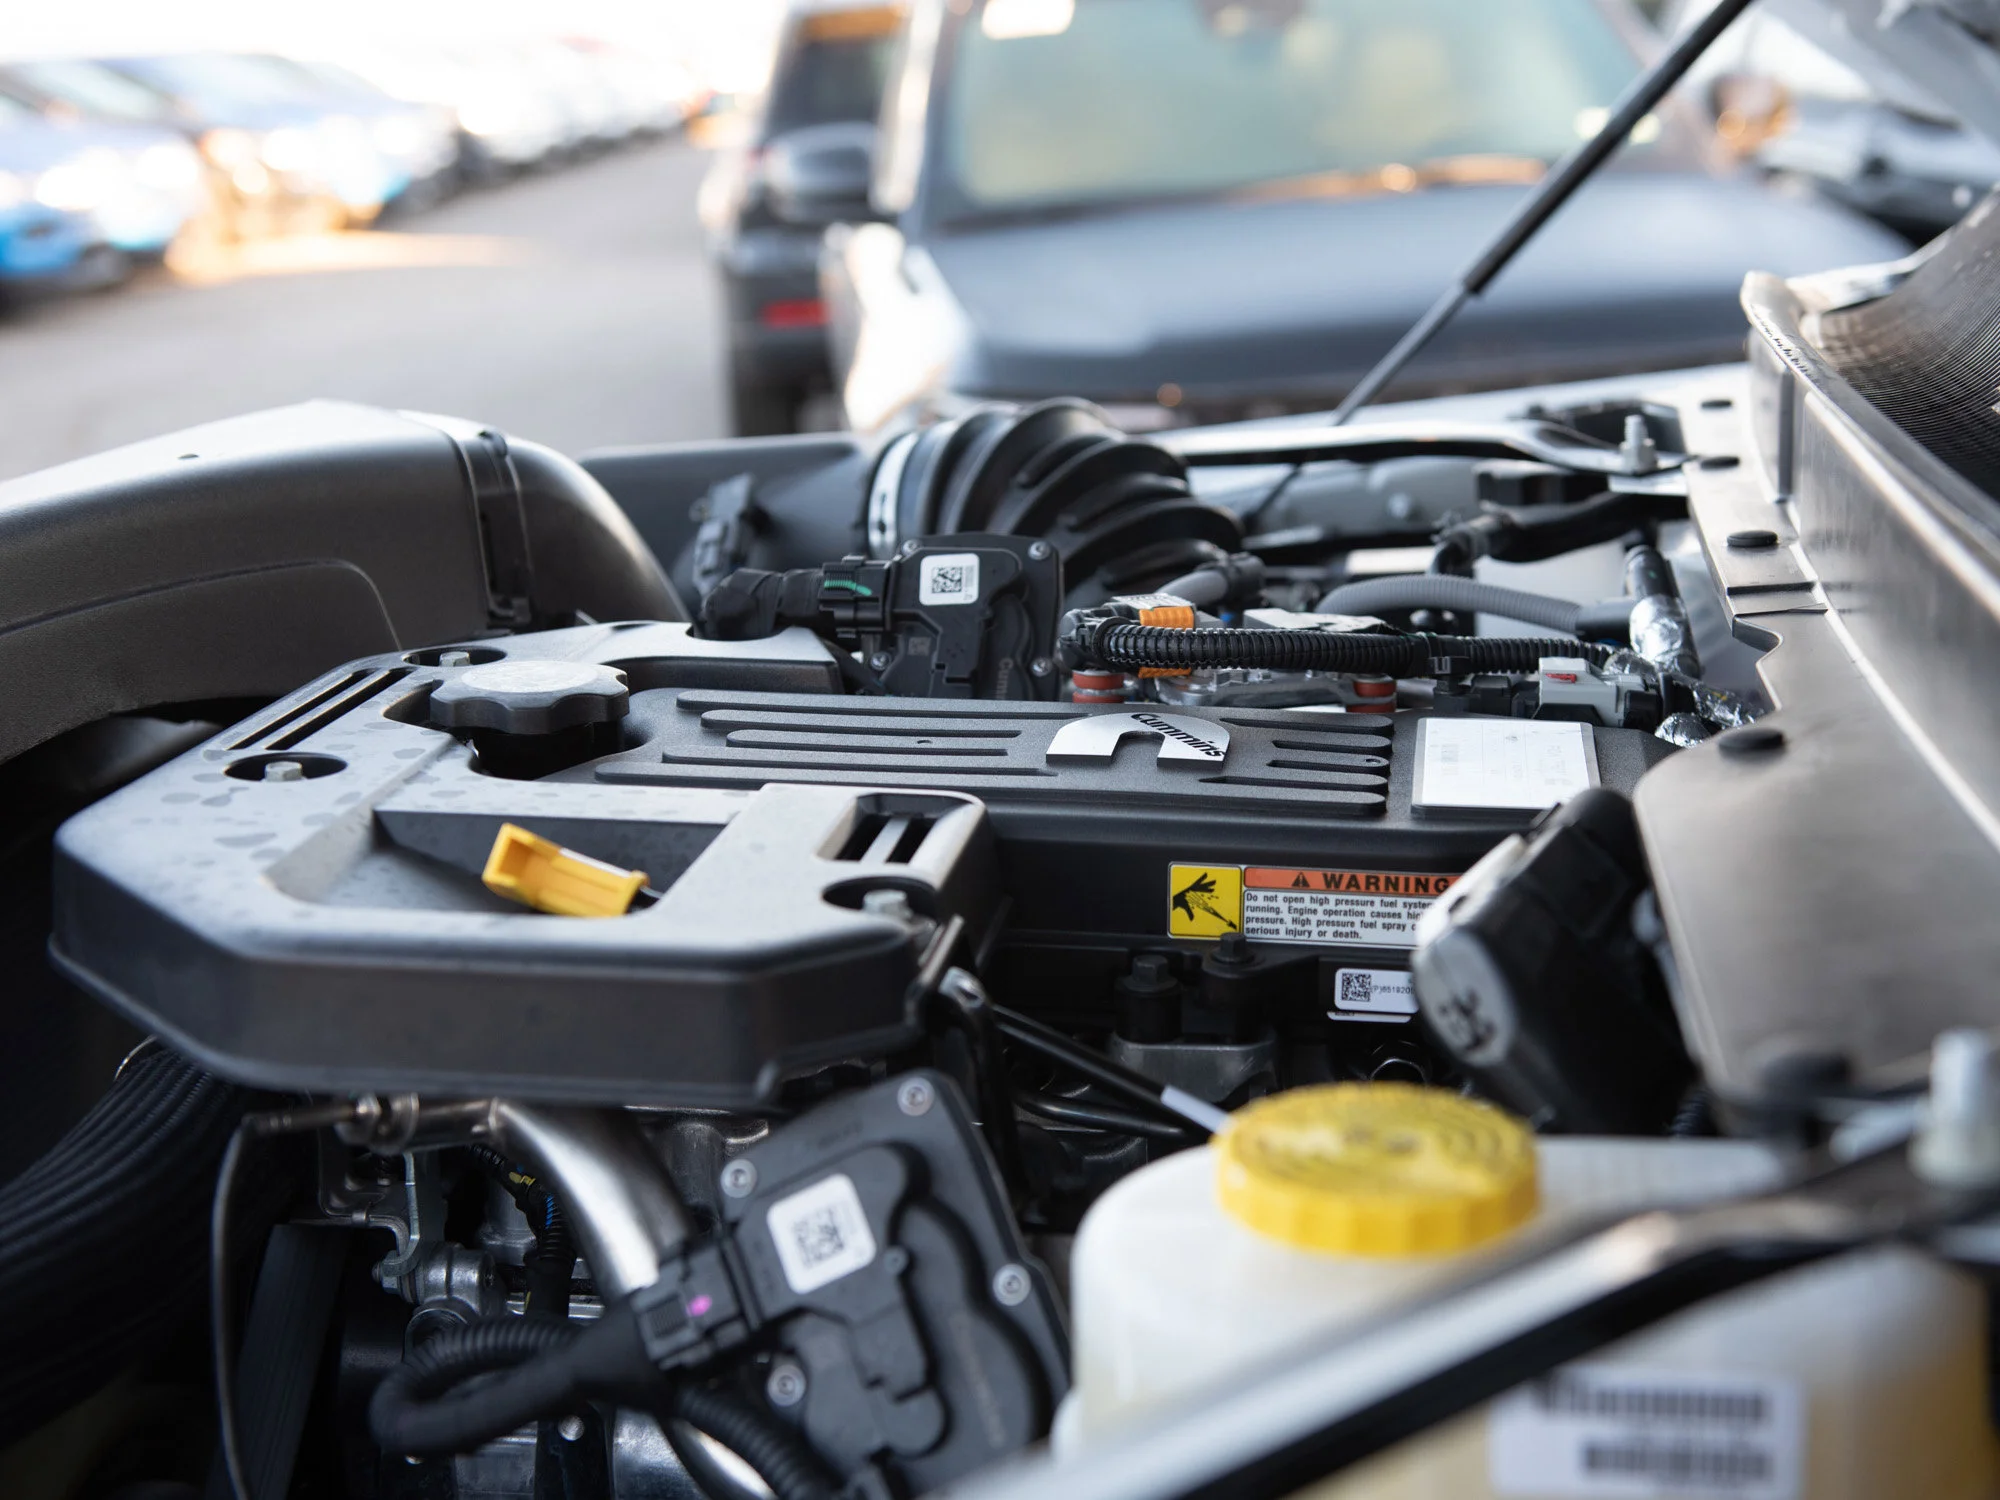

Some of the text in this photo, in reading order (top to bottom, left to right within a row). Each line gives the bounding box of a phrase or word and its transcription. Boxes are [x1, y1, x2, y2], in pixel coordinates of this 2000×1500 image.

[1130, 713, 1226, 758] Cummins
[1323, 873, 1449, 893] WARNING
[1246, 892, 1258, 902] Do
[1263, 894, 1278, 903] not
[1282, 896, 1305, 905] open
[1309, 896, 1330, 906] high
[1335, 898, 1375, 908] pressure
[1380, 900, 1397, 908] fuel
[1246, 906, 1282, 915] running.
[1288, 906, 1318, 916] Engine
[1323, 908, 1366, 918] operation
[1370, 911, 1402, 919] causes
[1245, 917, 1287, 926] pressure.
[1291, 917, 1312, 927] High
[1316, 919, 1356, 929] pressure
[1360, 920, 1377, 929] fuel
[1382, 922, 1407, 932] spray
[1245, 926, 1280, 936] serious
[1285, 927, 1312, 939] injury
[1332, 930, 1362, 939] death.
